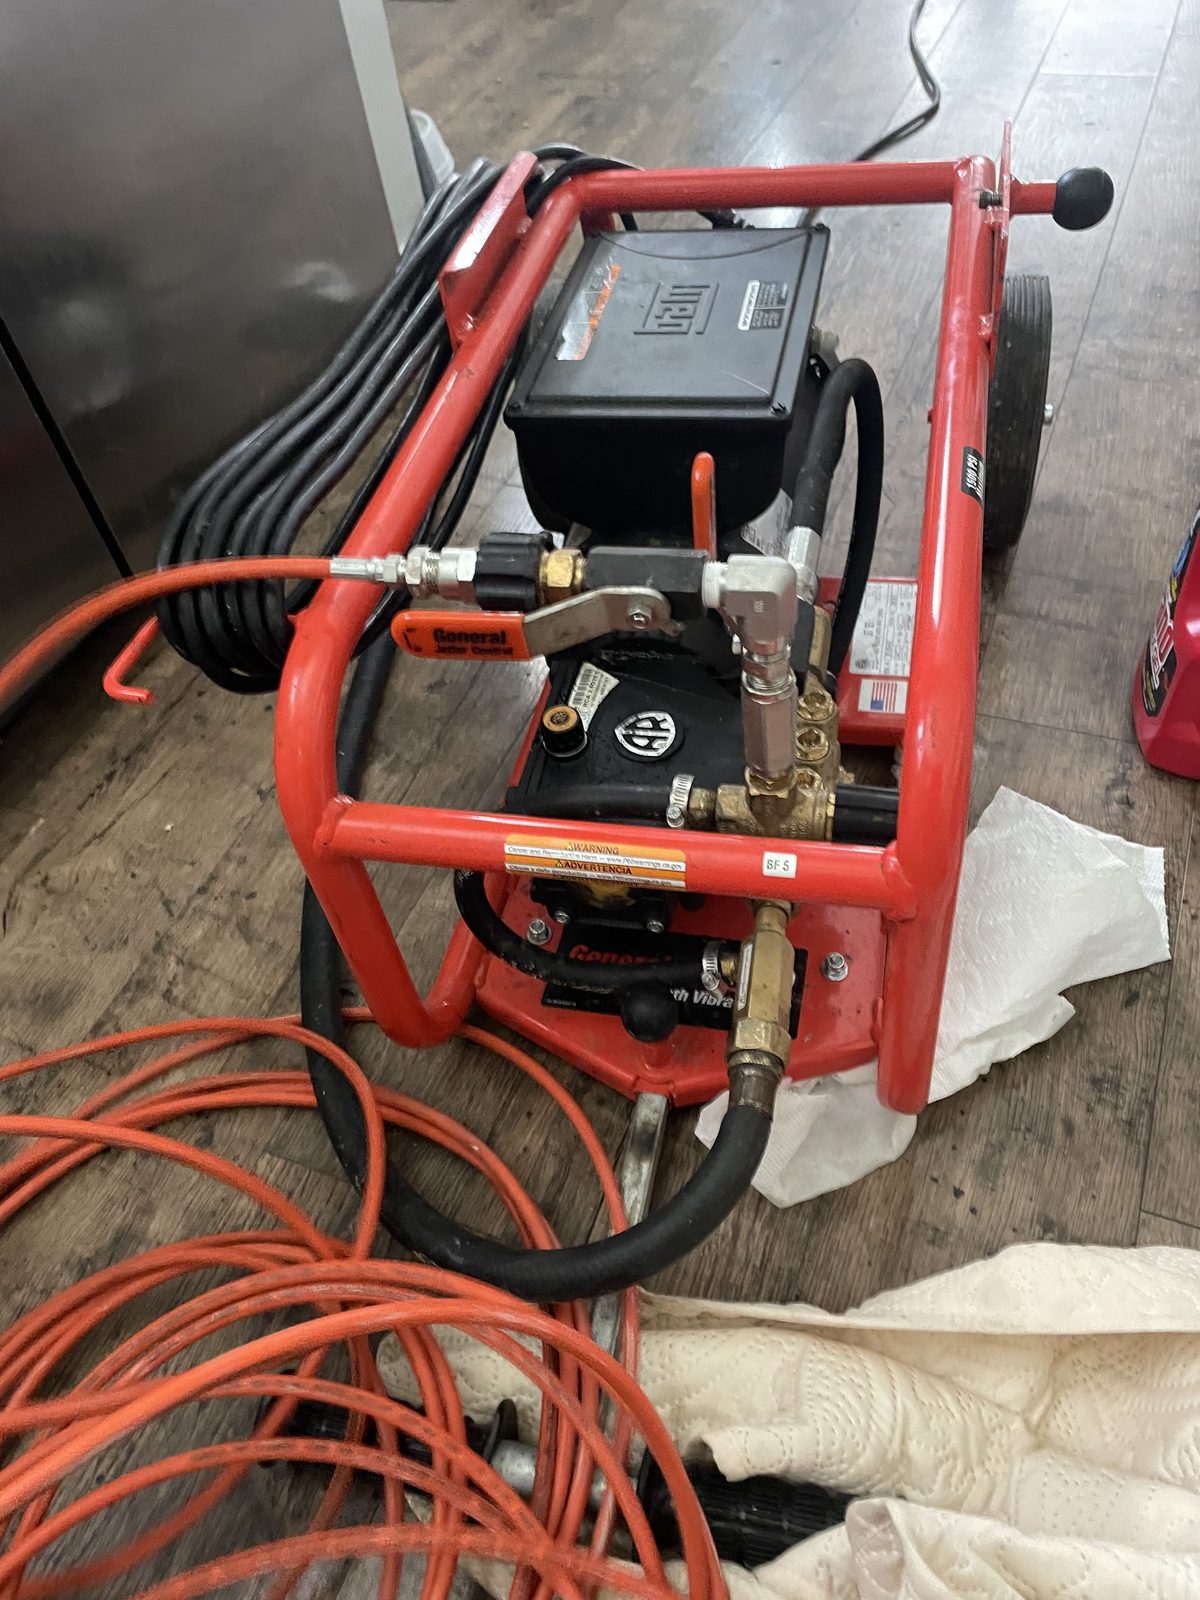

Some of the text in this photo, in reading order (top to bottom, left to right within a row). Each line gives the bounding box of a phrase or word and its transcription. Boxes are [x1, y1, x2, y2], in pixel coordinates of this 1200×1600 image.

[966, 454, 978, 489] 1500 PSI
[433, 628, 507, 645] General
[508, 846, 528, 854] Cancer
[531, 847, 541, 855] and
[573, 841, 620, 855] WARNING
[565, 859, 633, 875] ADVERTENCIA
[782, 860, 790, 872] 5
